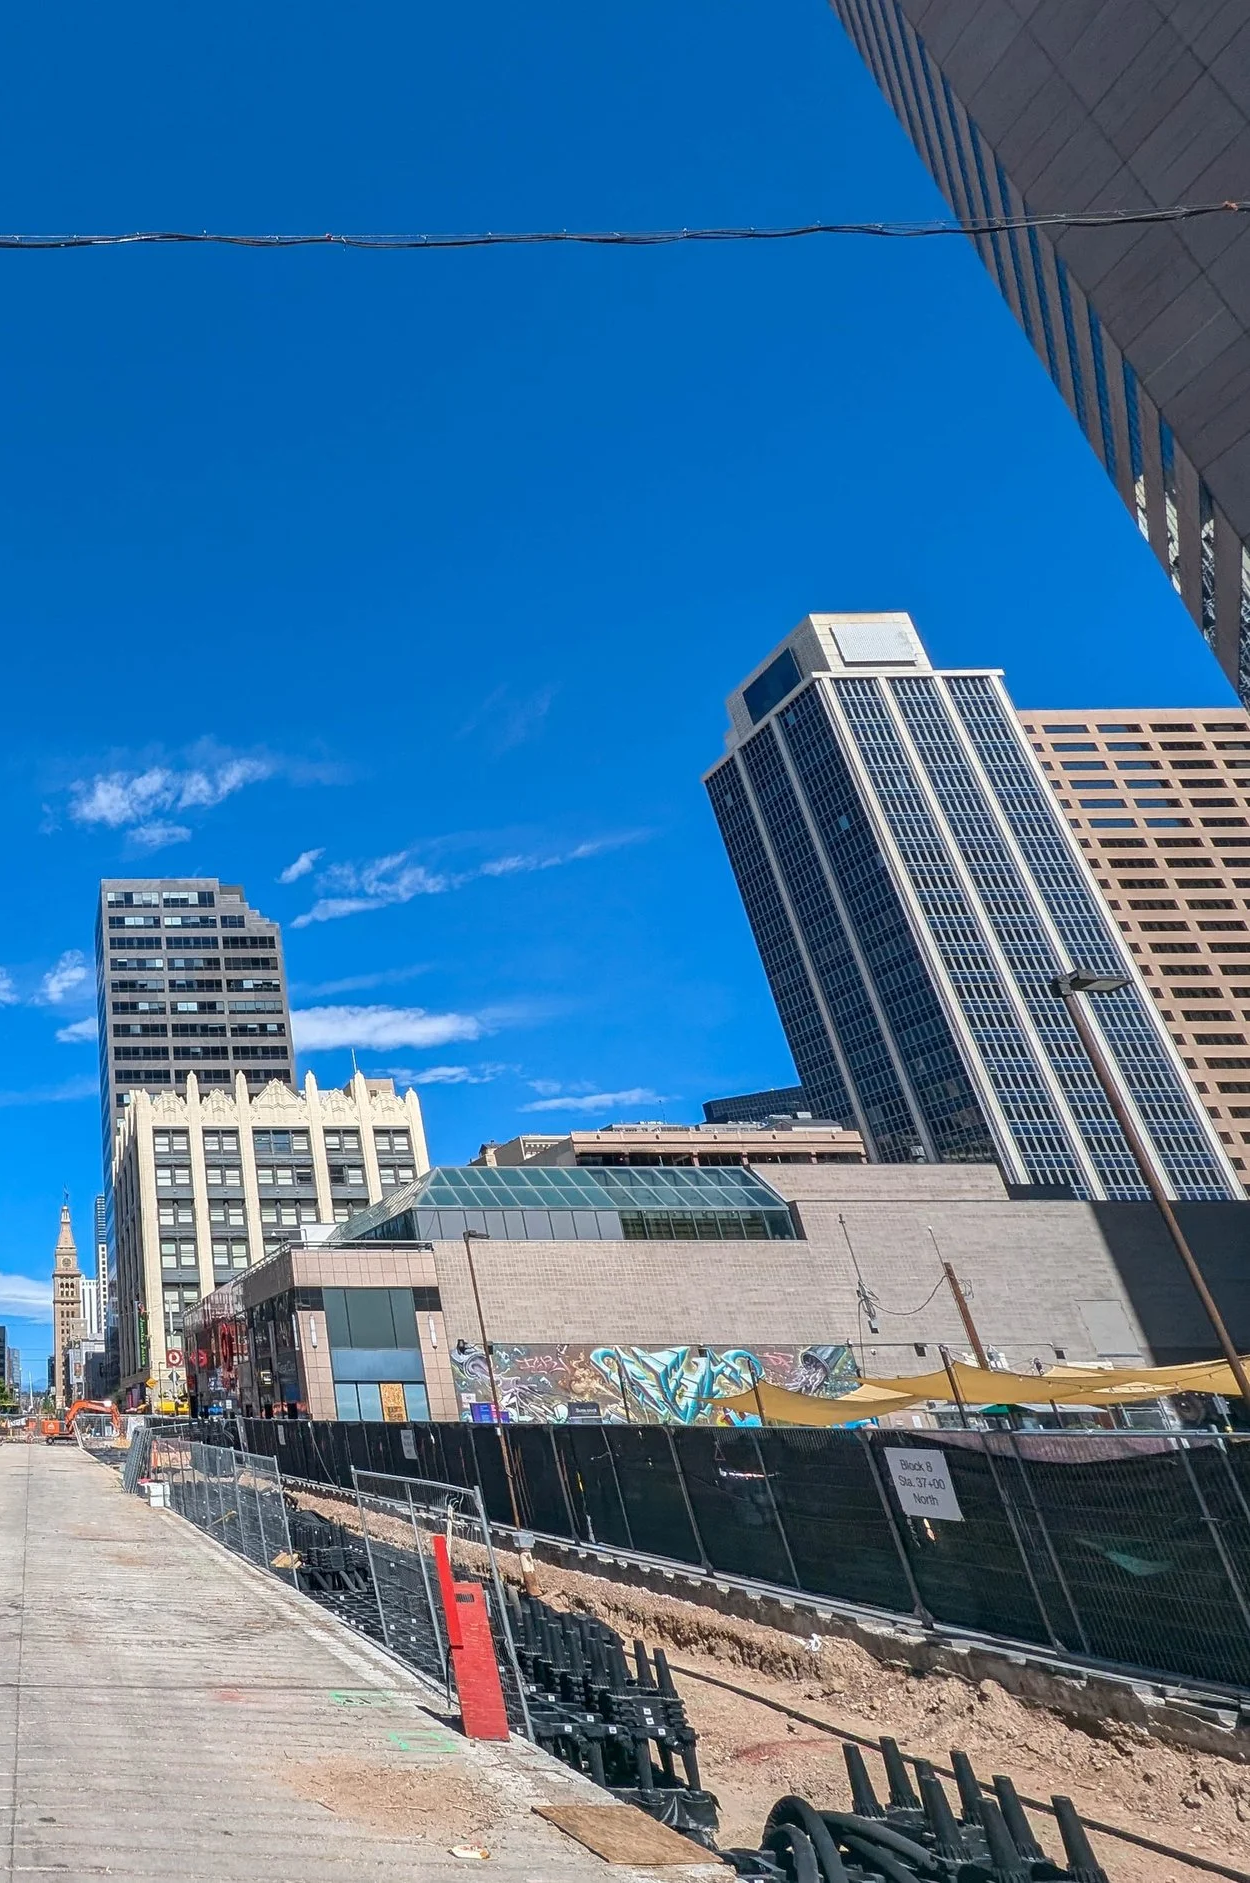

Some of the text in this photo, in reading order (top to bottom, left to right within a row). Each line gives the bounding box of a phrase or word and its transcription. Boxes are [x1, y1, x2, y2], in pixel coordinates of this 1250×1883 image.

[900, 1459, 933, 1472] Block 8
[898, 1475, 946, 1490] Sta. 37+00
[913, 1492, 940, 1506] North
